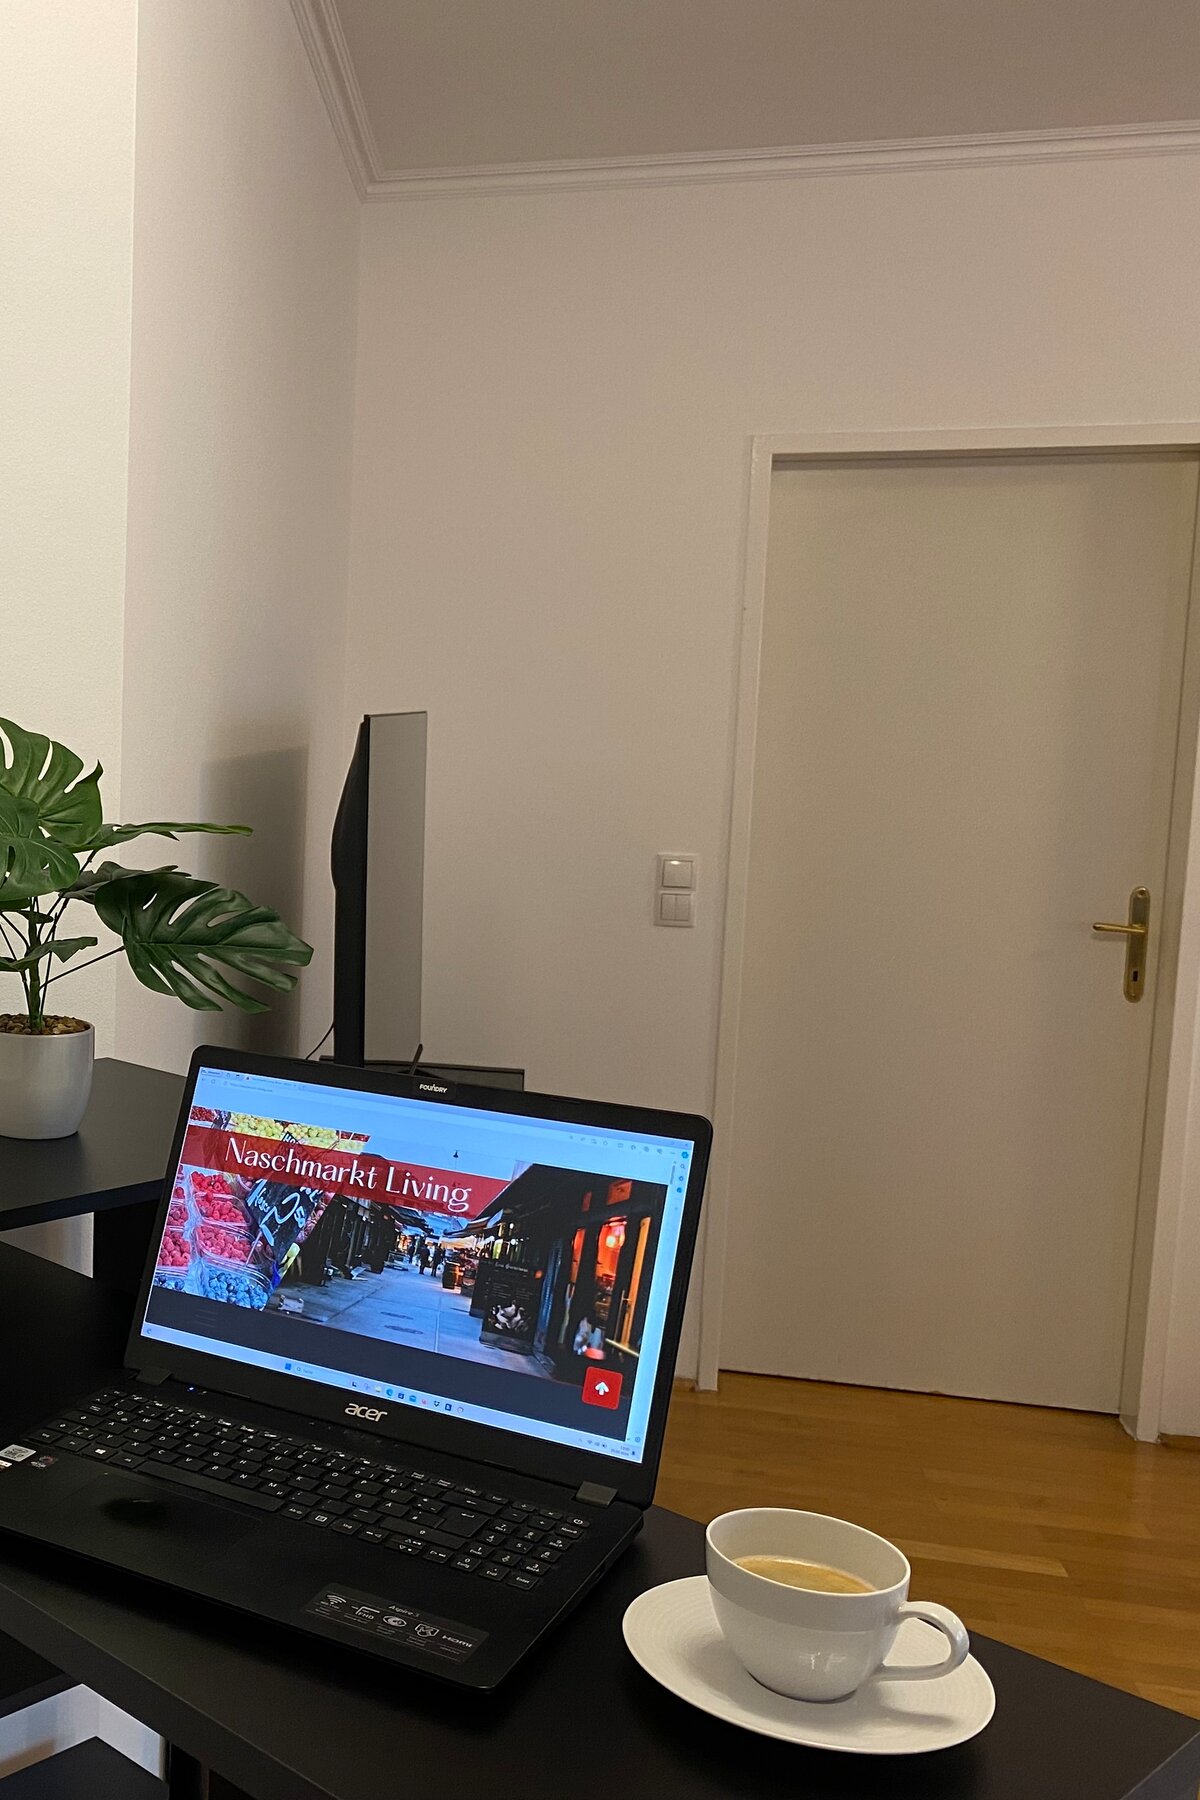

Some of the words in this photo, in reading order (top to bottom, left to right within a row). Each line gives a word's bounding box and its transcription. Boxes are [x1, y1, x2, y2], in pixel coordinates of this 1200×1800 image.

[419, 1083, 448, 1093] FOUNDRY
[225, 1137, 378, 1190] Naschmarkt
[385, 1166, 472, 1213] Living
[344, 1402, 388, 1422] acer
